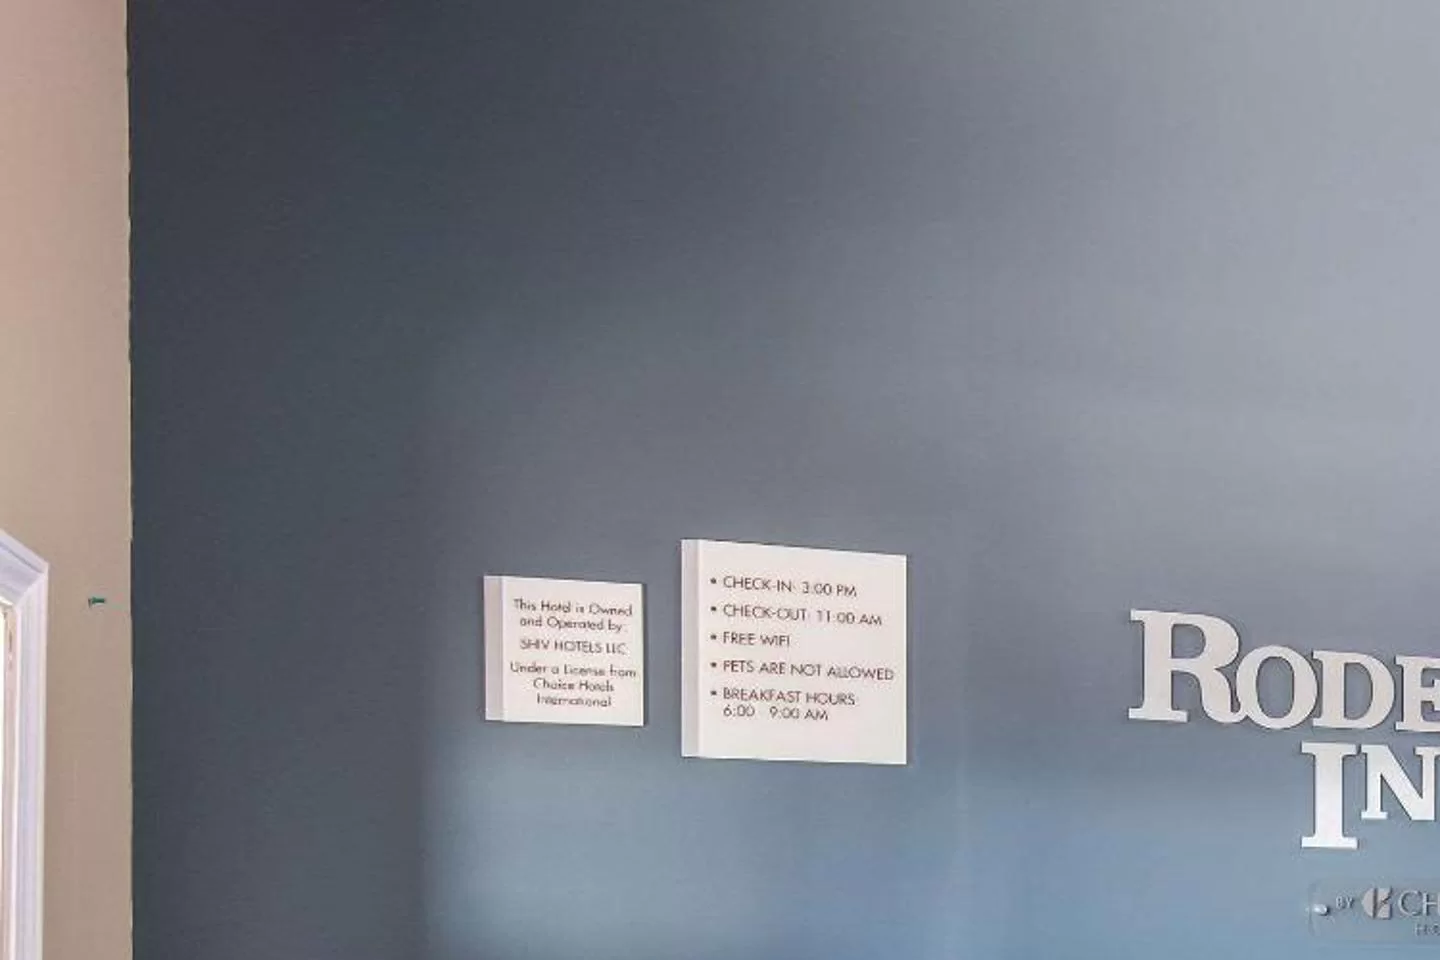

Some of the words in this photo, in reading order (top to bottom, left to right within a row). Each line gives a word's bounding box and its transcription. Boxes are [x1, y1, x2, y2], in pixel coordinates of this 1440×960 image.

[801, 581, 833, 596] 3:00
[835, 584, 858, 598] PM
[513, 596, 537, 611] This
[541, 599, 572, 614] Hotel
[575, 603, 585, 614] is
[589, 603, 633, 617] Owned
[520, 616, 543, 627] and
[547, 616, 604, 630] Operated
[816, 609, 856, 625] 11:00
[859, 613, 883, 627] AM
[722, 631, 755, 646] FREE
[759, 633, 790, 648] WIFI
[554, 641, 604, 654] HOTELS
[606, 643, 628, 656] LLC
[510, 661, 548, 674] Under
[551, 665, 560, 675] a
[563, 664, 606, 677] License
[609, 664, 637, 678] from
[722, 660, 755, 674] PETS
[759, 661, 787, 676] ARE
[790, 663, 822, 678] NOT
[827, 666, 895, 681] ALLOWED
[533, 677, 575, 691] Choice
[579, 680, 615, 693] Hotels
[537, 693, 612, 707] International
[722, 687, 801, 704] BREAKFAST
[723, 704, 755, 718] 6:00
[769, 705, 800, 720] 9:00
[804, 708, 829, 721] AM
[1335, 896, 1353, 910] BY
